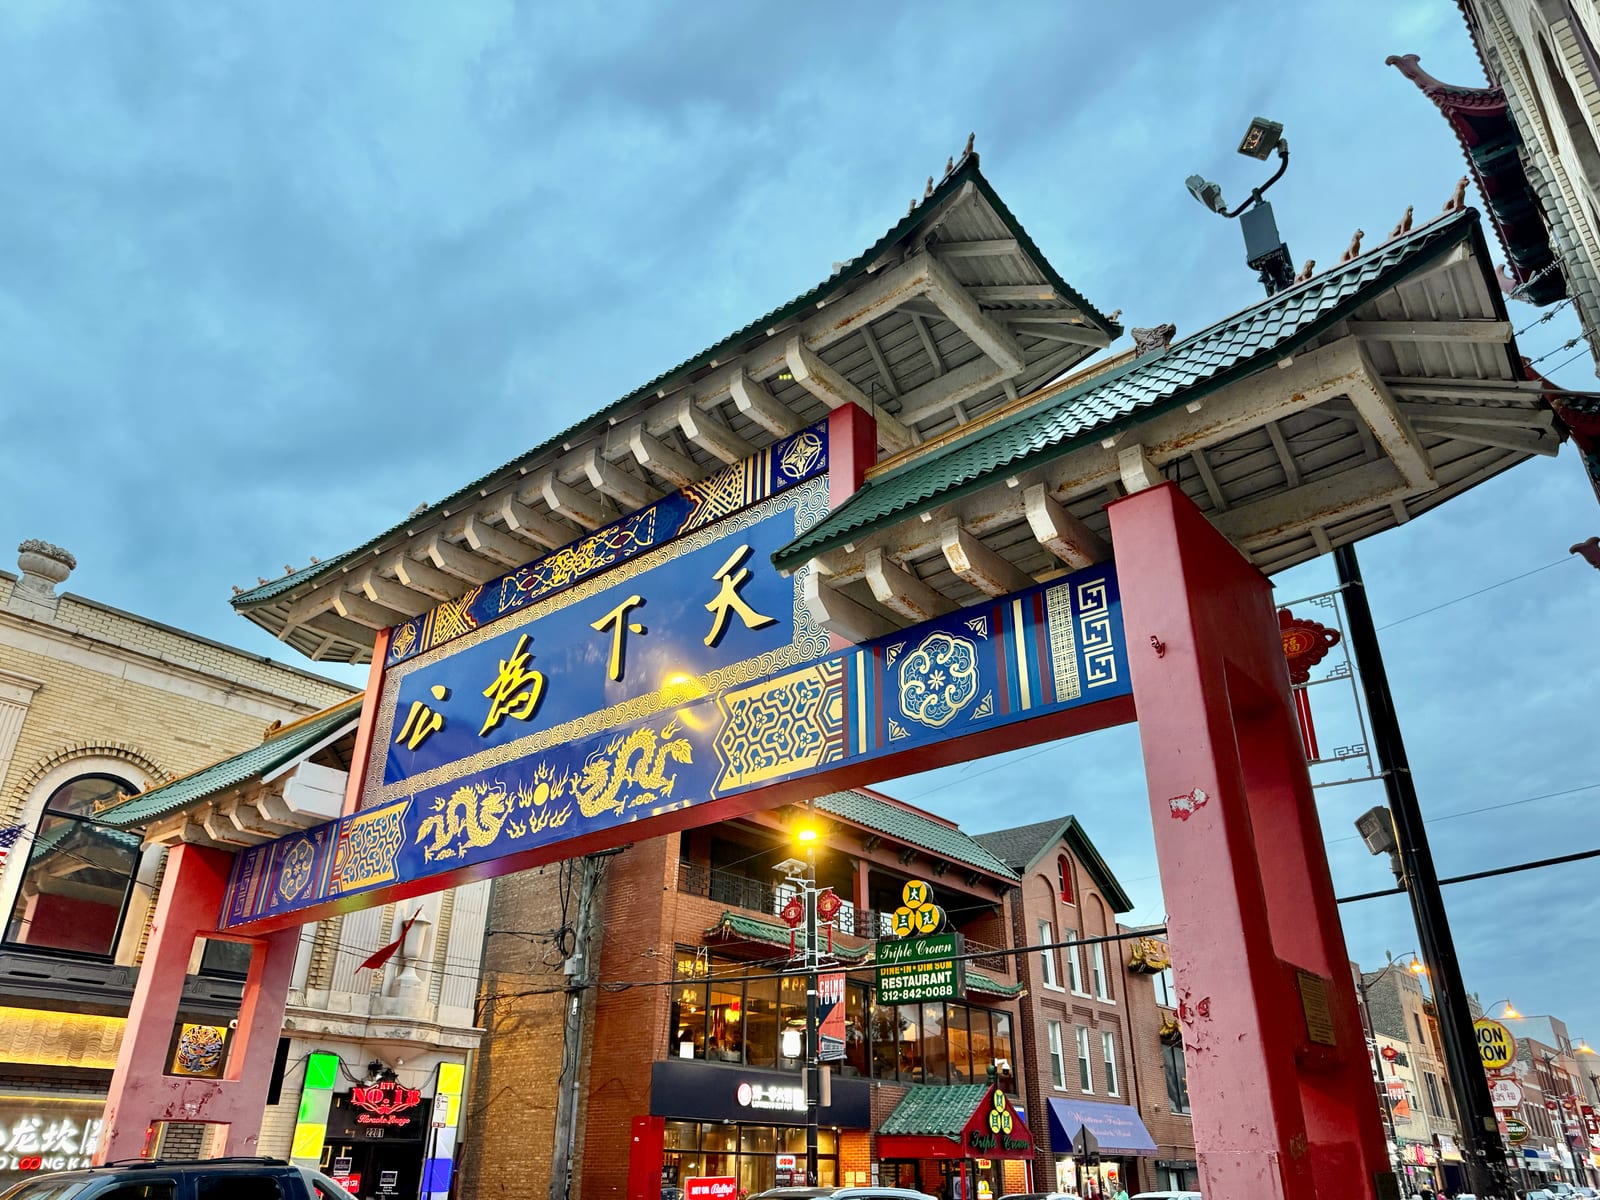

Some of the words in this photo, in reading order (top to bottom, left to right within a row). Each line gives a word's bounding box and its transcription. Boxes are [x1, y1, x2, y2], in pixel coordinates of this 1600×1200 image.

[909, 888, 920, 900] 大
[898, 915, 908, 927] 三
[923, 912, 933, 925] 元
[880, 943, 913, 964] Triple
[915, 939, 953, 956] Crown
[819, 978, 845, 994] CHINA
[881, 970, 953, 990] RESTAURANT
[819, 990, 845, 1006] TOWN
[881, 985, 954, 1001] 312-842-0088
